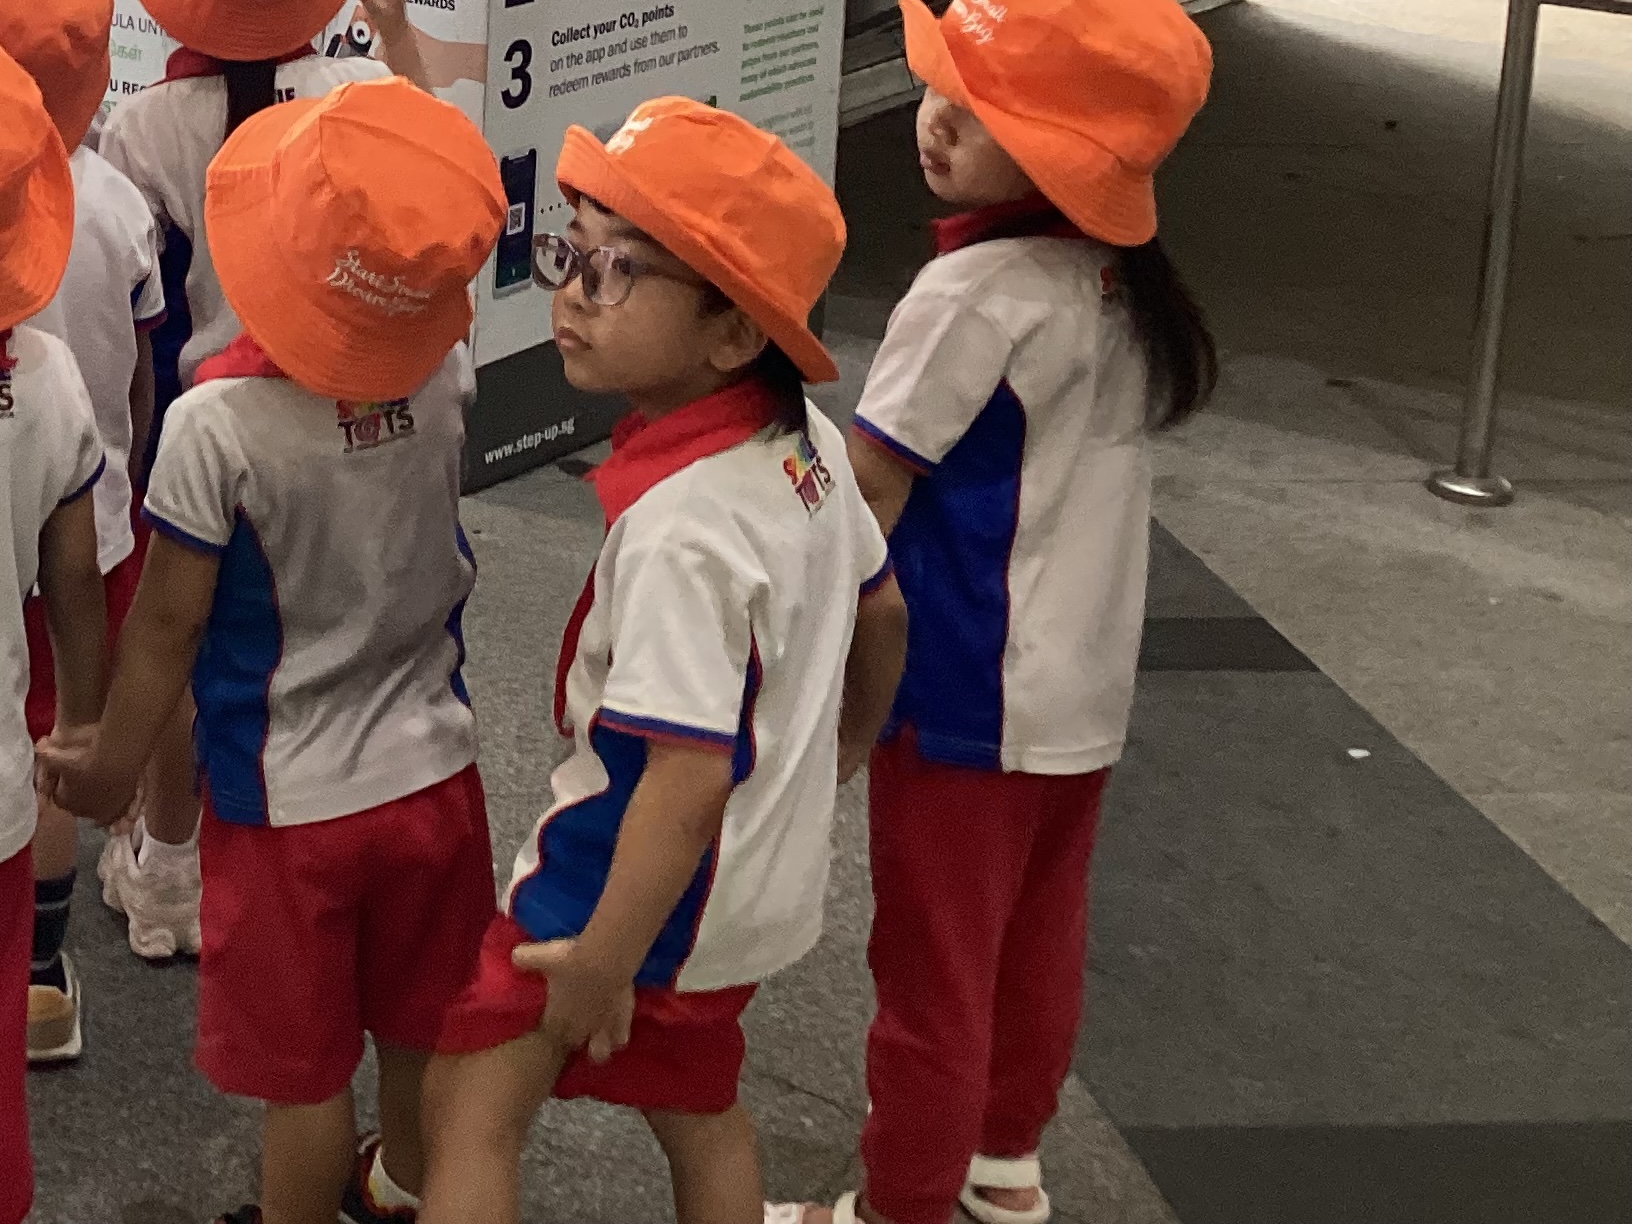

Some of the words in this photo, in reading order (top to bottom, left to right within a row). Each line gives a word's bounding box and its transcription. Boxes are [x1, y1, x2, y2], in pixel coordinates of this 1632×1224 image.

[550, 58, 565, 74] on
[566, 52, 584, 69] the
[585, 48, 606, 68] app
[608, 39, 628, 57] and
[630, 36, 648, 52] use
[650, 28, 676, 48] them
[678, 25, 688, 40] to
[551, 23, 592, 48] Collect
[593, 18, 617, 42] your
[641, 3, 675, 27] points
[501, 38, 533, 110] 3
[548, 75, 590, 99] redeem
[591, 63, 631, 86] rewards
[633, 58, 658, 76] from
[658, 53, 676, 71] our
[485, 416, 575, 464] www.step-up.sg
